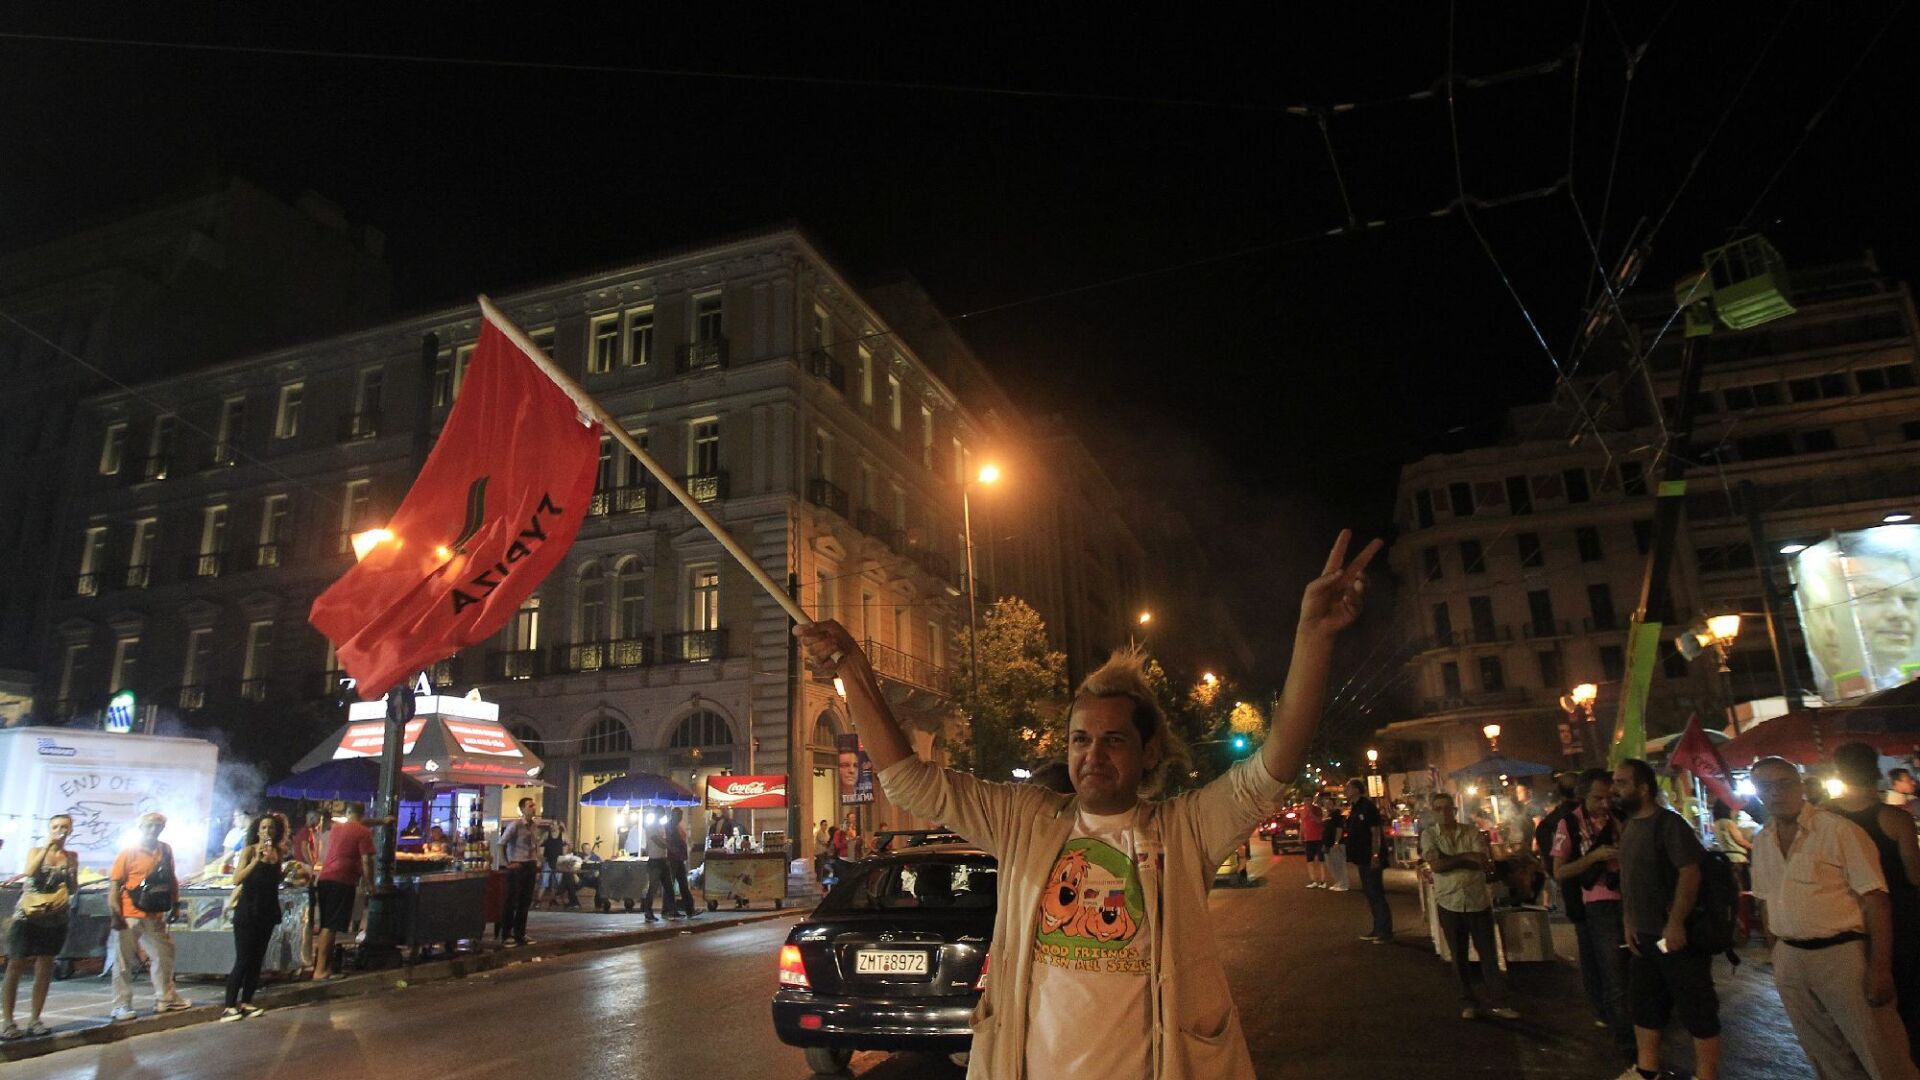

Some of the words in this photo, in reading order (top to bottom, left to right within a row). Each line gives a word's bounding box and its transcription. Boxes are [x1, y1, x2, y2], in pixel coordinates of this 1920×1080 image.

[60, 774, 101, 797] END
[1035, 943, 1069, 957] OOD
[1075, 946, 1139, 960] FRIENDS
[860, 954, 883, 971] ZMT
[890, 954, 924, 971] 8972
[1075, 959, 1101, 973] ALL
